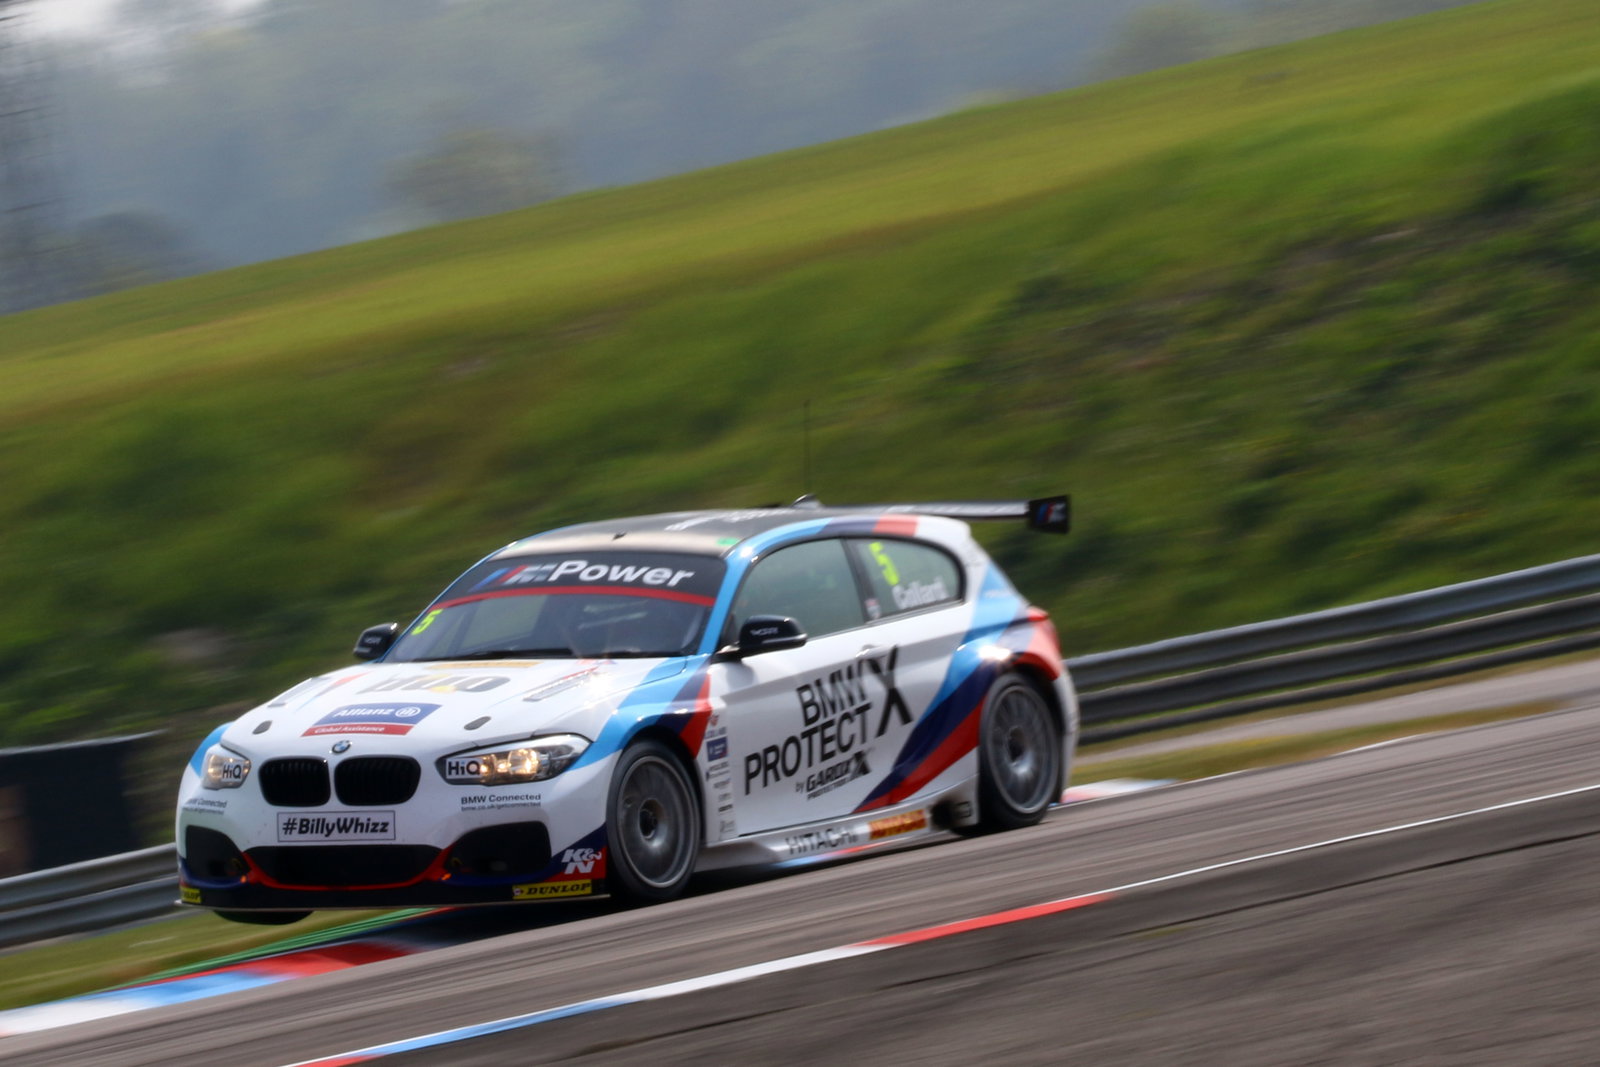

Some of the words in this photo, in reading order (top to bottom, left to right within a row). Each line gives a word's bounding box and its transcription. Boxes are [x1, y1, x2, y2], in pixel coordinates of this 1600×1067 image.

[548, 560, 694, 587] Power
[869, 542, 899, 586] 5
[411, 609, 443, 635] 5
[796, 659, 868, 726] BMW
[334, 708, 395, 717] Allianz
[745, 702, 872, 796] PROTECT
[222, 764, 242, 779] HiQ
[448, 760, 481, 776] HiQ
[461, 796, 487, 806] BMW
[488, 793, 541, 802] Connected
[282, 817, 390, 837] #BillyWhizz
[526, 882, 592, 895] DUNLOP
